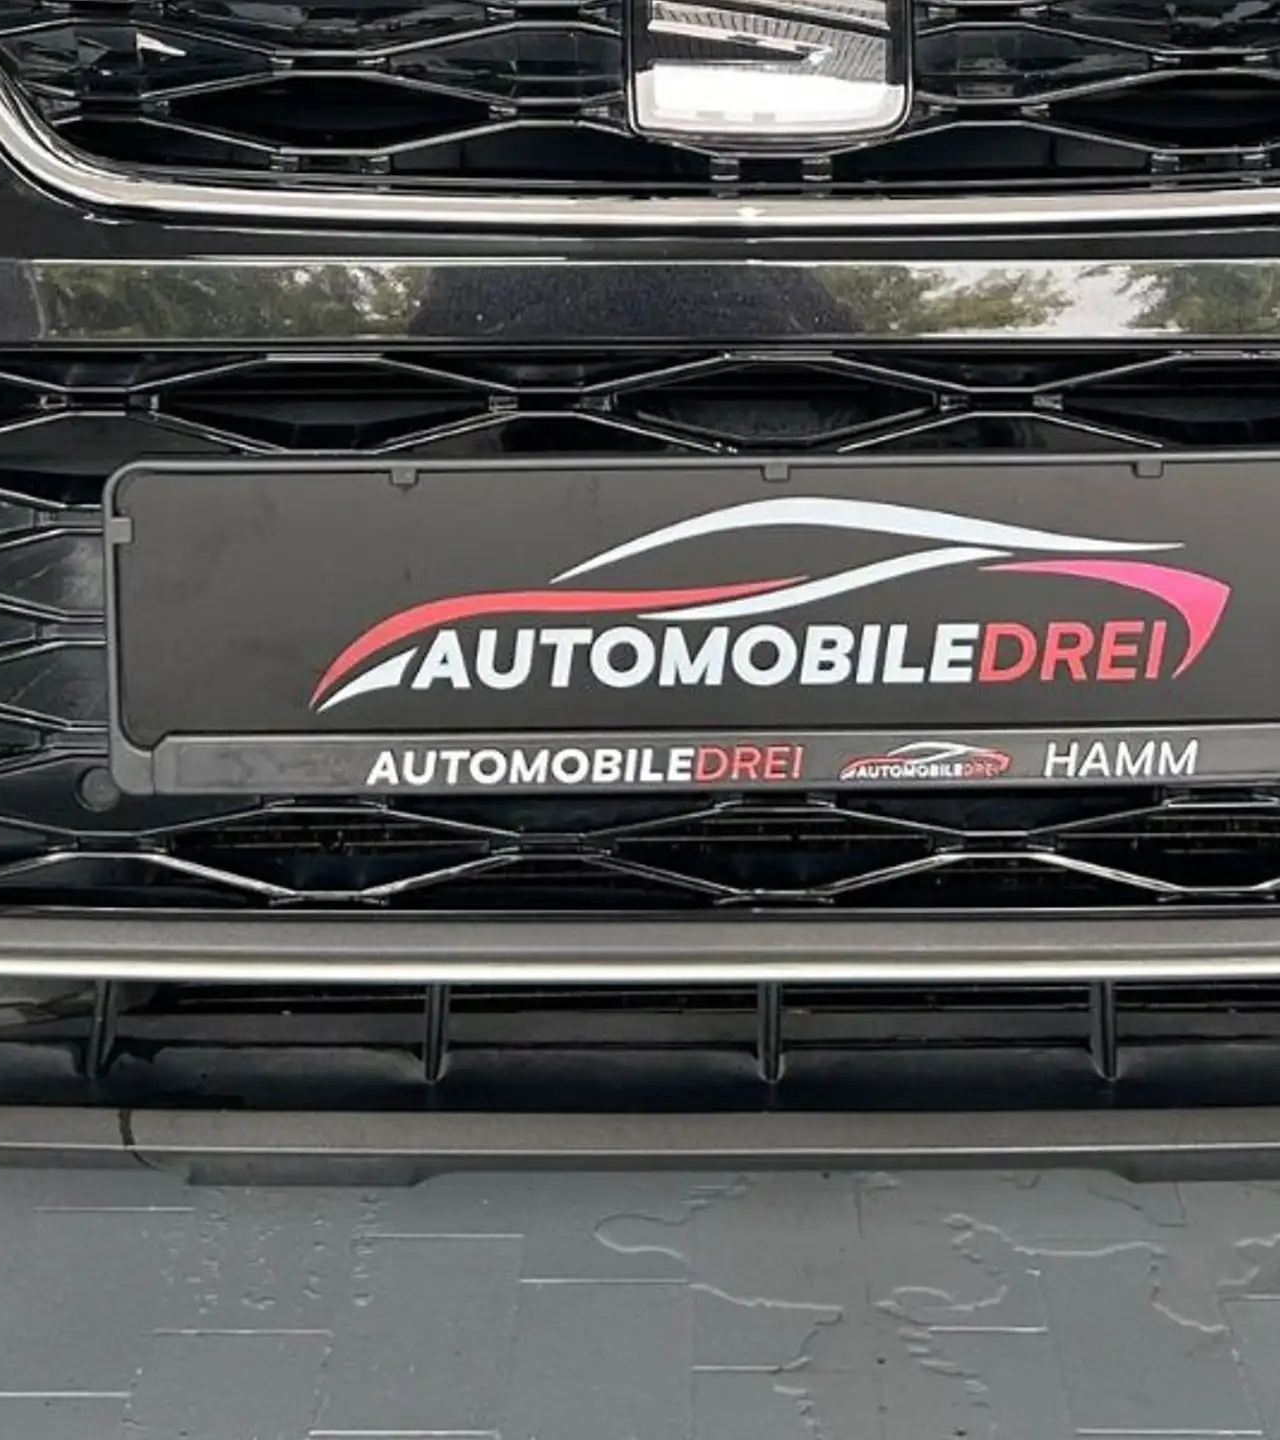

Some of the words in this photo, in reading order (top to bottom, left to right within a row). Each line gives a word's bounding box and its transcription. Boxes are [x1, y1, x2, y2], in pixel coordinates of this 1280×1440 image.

[411, 621, 1167, 690] AUTOMOBILEDREI
[366, 744, 804, 786] AUTOMOBILEDREI
[1042, 739, 1199, 777] HAMM
